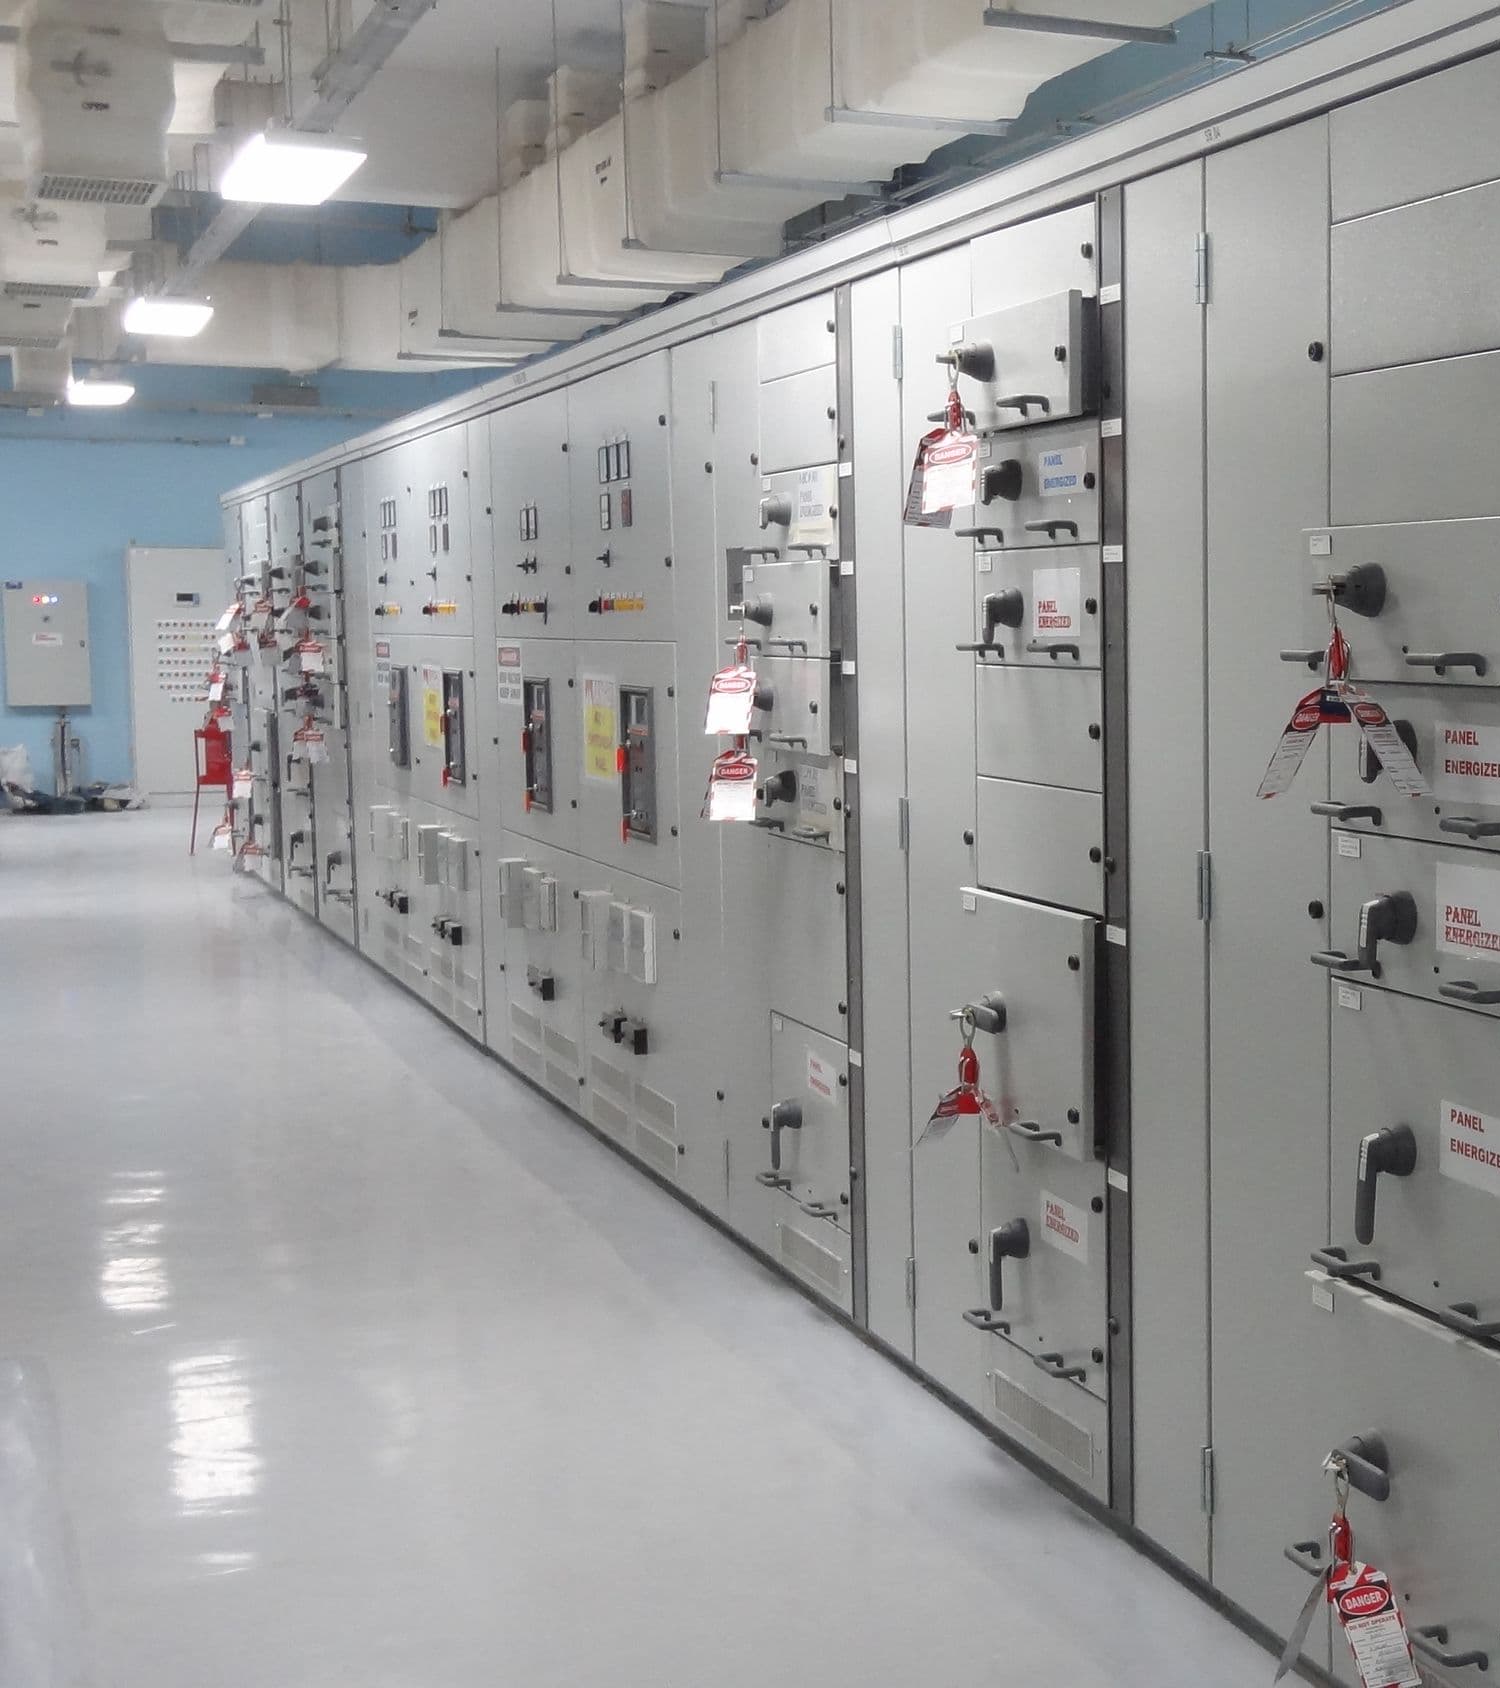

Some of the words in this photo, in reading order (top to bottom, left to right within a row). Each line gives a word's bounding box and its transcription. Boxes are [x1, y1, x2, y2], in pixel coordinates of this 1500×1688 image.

[1445, 729, 1479, 746] PANEL
[1445, 905, 1481, 927] PANEL
[1450, 1109, 1485, 1133] PANEL
[1345, 1591, 1384, 1610] DANGER
